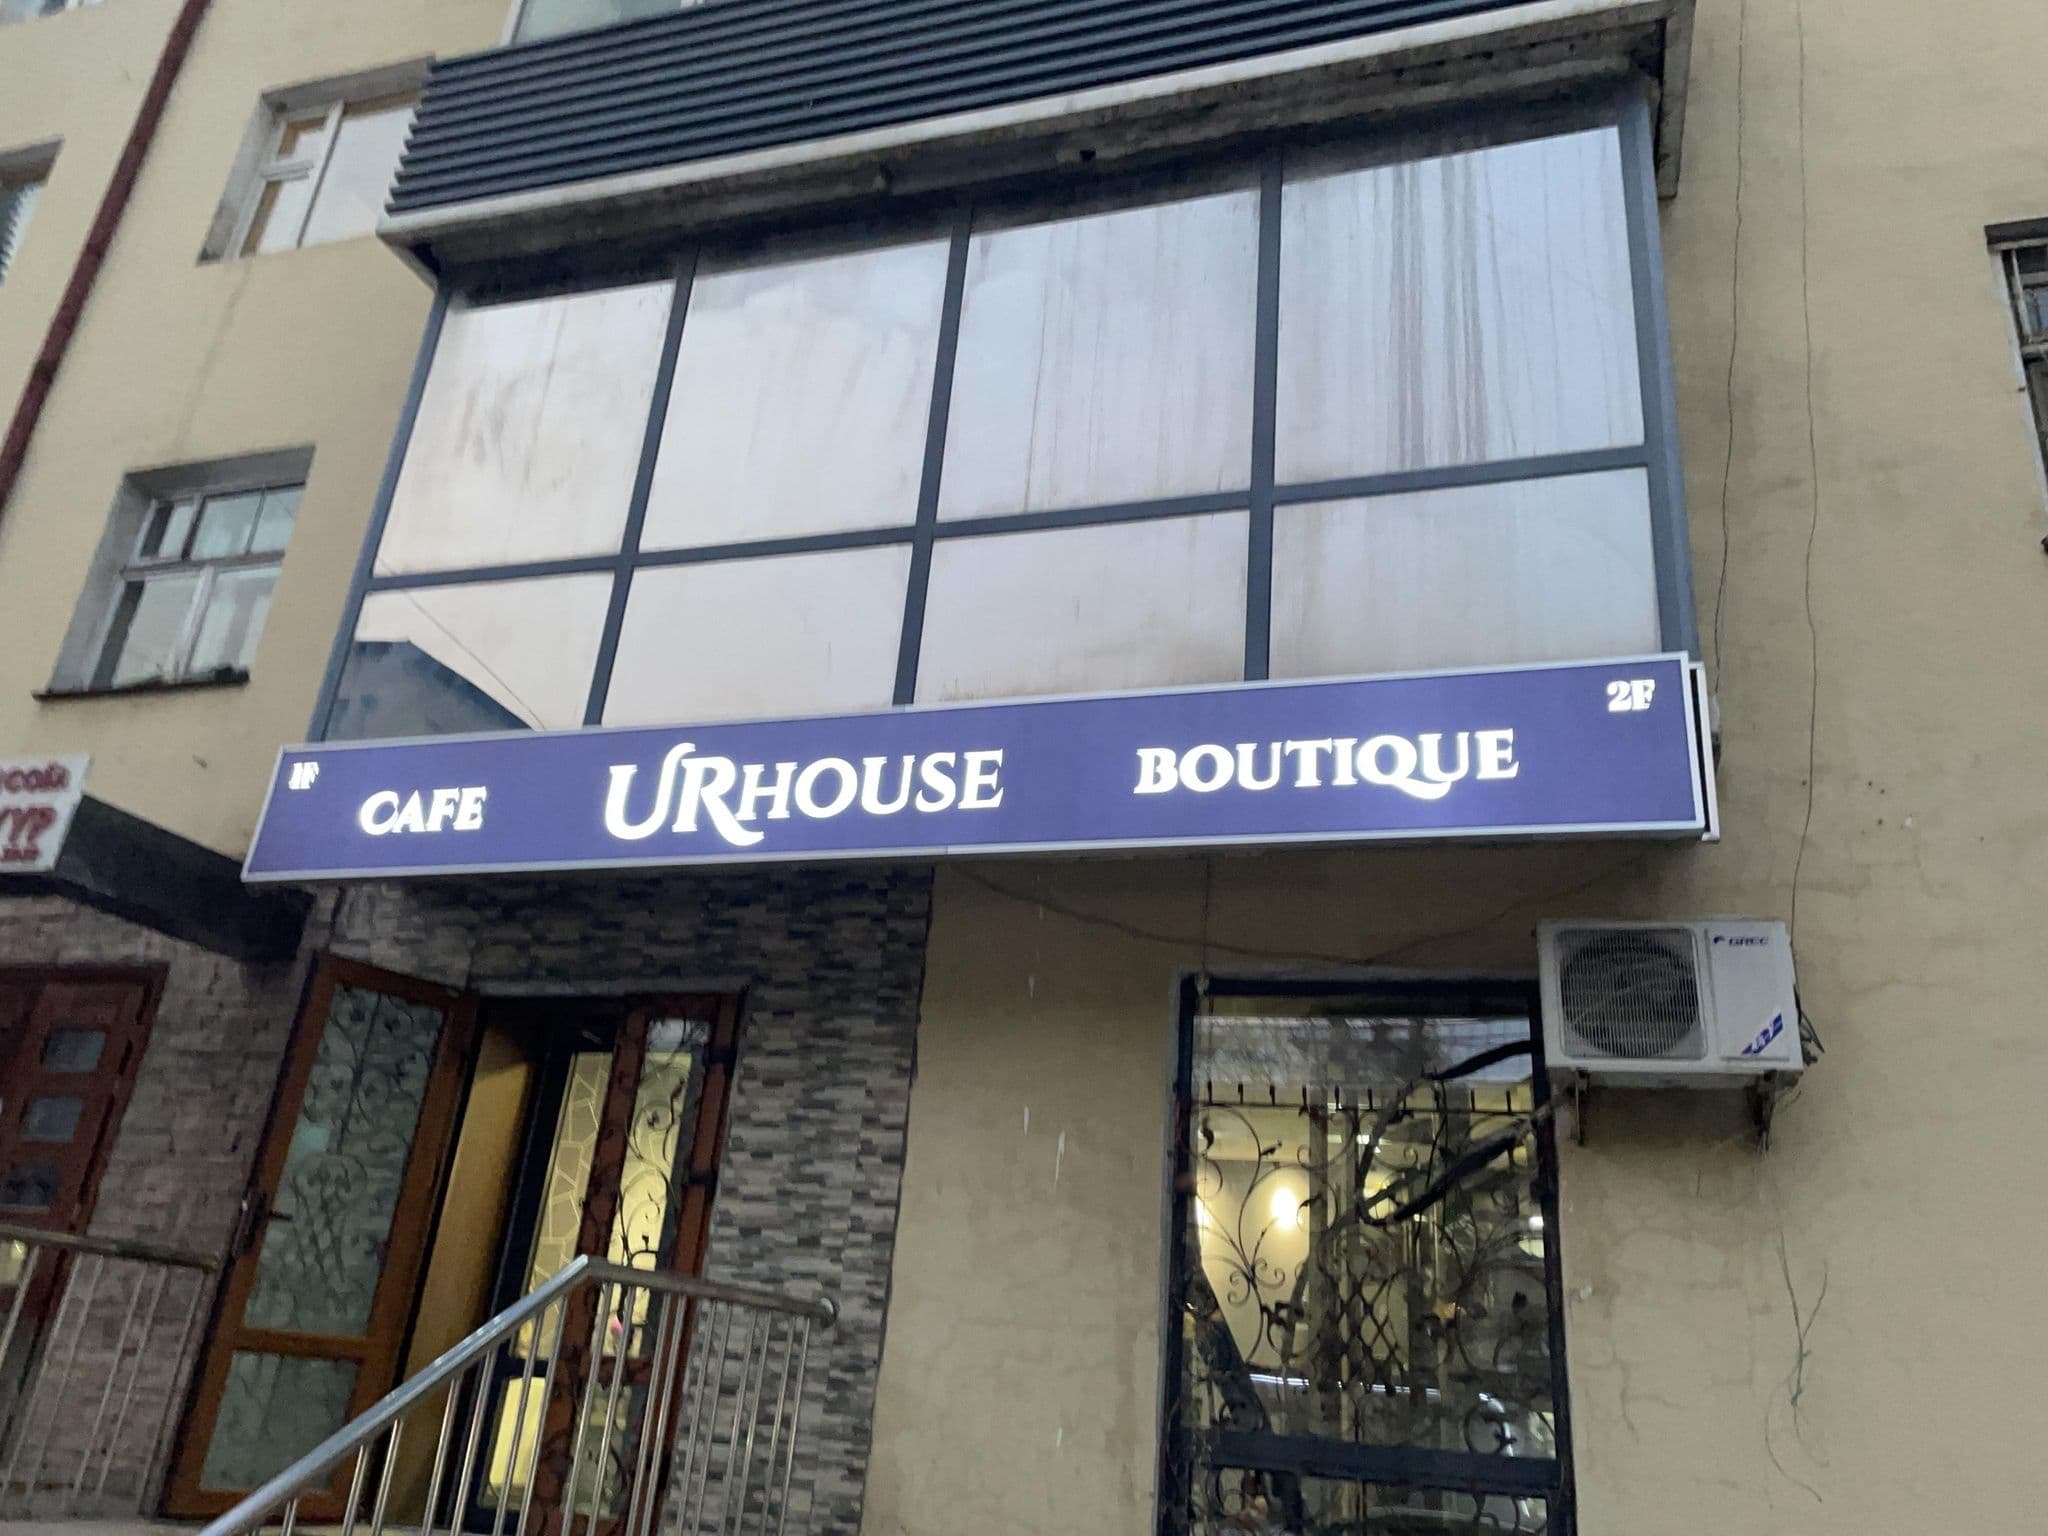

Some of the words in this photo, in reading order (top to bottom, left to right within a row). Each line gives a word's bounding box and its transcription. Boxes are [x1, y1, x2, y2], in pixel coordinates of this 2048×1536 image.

[1606, 679, 1656, 712] 2F
[358, 786, 487, 836] CAFE
[604, 742, 1004, 847] URHOUSE
[1133, 728, 1519, 801] BOUTIQUE
